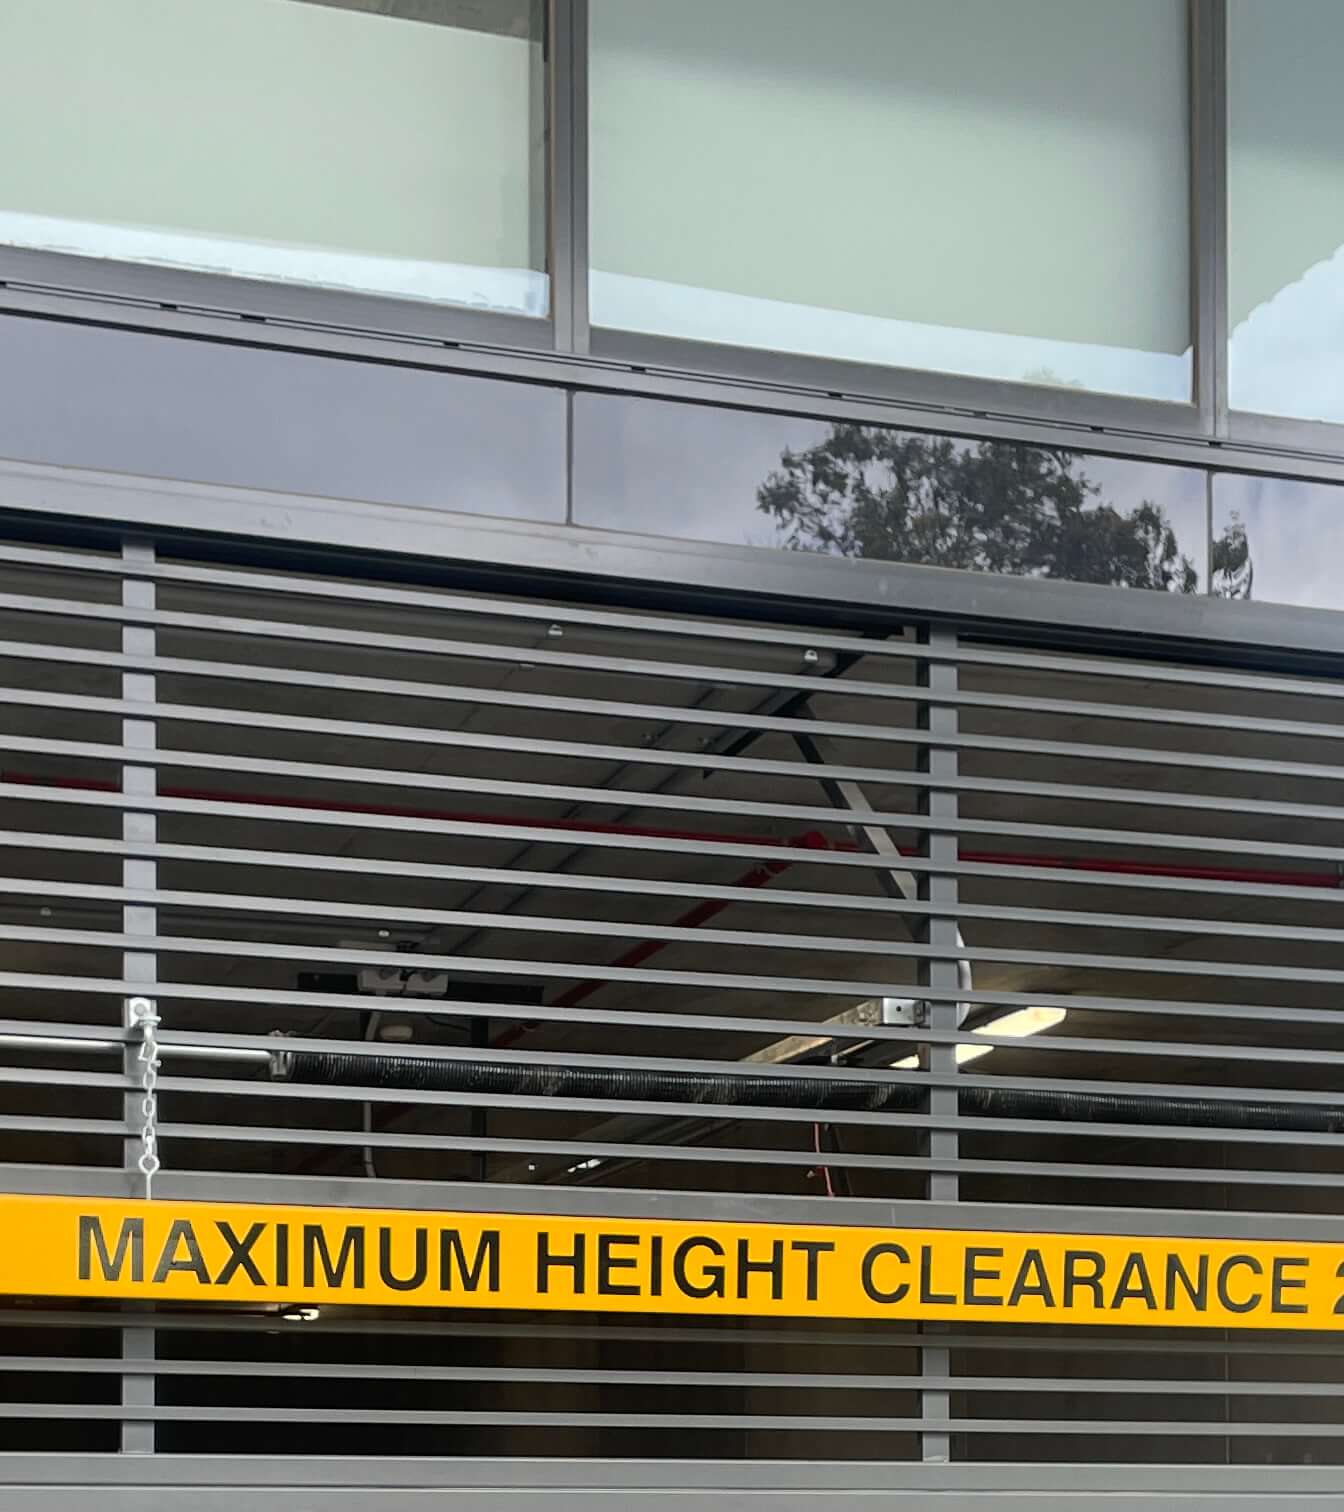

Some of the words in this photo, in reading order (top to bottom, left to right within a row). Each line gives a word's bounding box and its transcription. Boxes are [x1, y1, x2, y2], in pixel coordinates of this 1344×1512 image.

[77, 1214, 501, 1293] MAXIMUM
[535, 1230, 836, 1302] HEIGHT
[860, 1242, 1310, 1315] CLEARANCE
